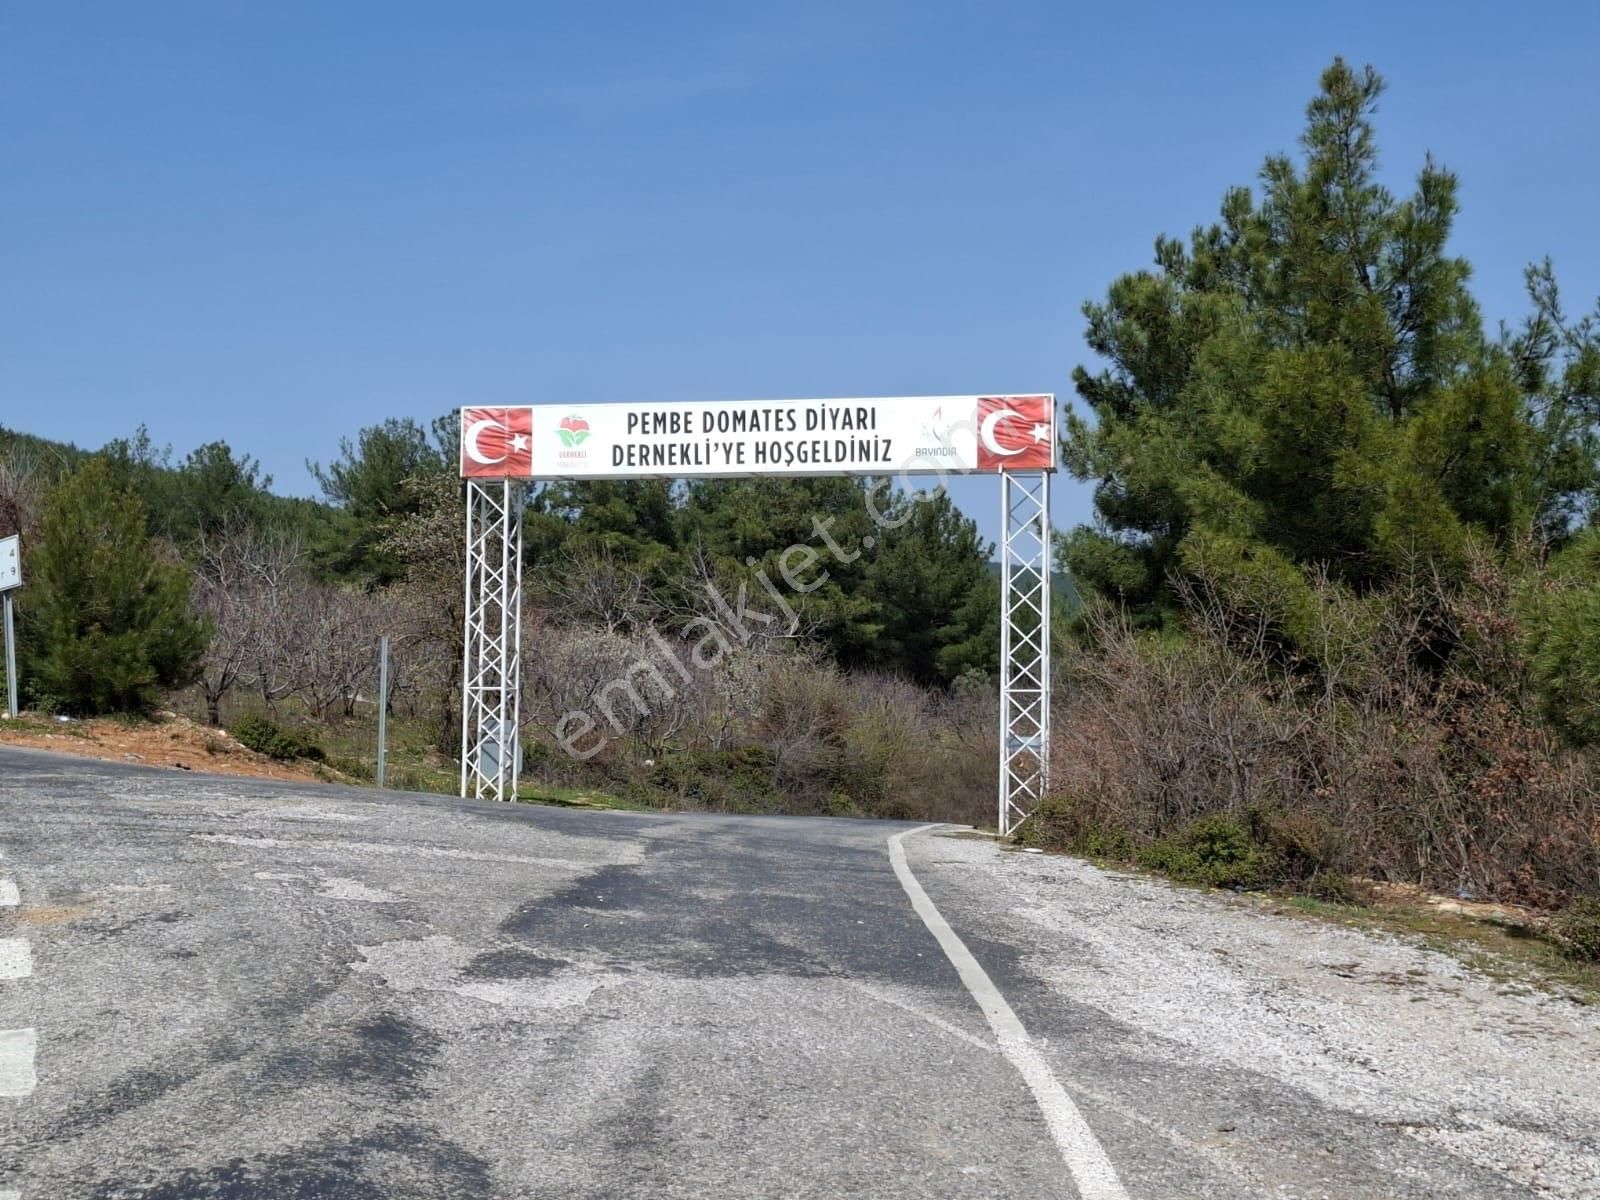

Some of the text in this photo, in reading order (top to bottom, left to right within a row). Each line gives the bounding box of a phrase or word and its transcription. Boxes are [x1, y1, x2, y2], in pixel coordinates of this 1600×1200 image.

[627, 403, 876, 434] PEMBE DOMATES DİYARI
[612, 435, 892, 467] DERNEKLİ’YE HOŞGELDİNİZ
